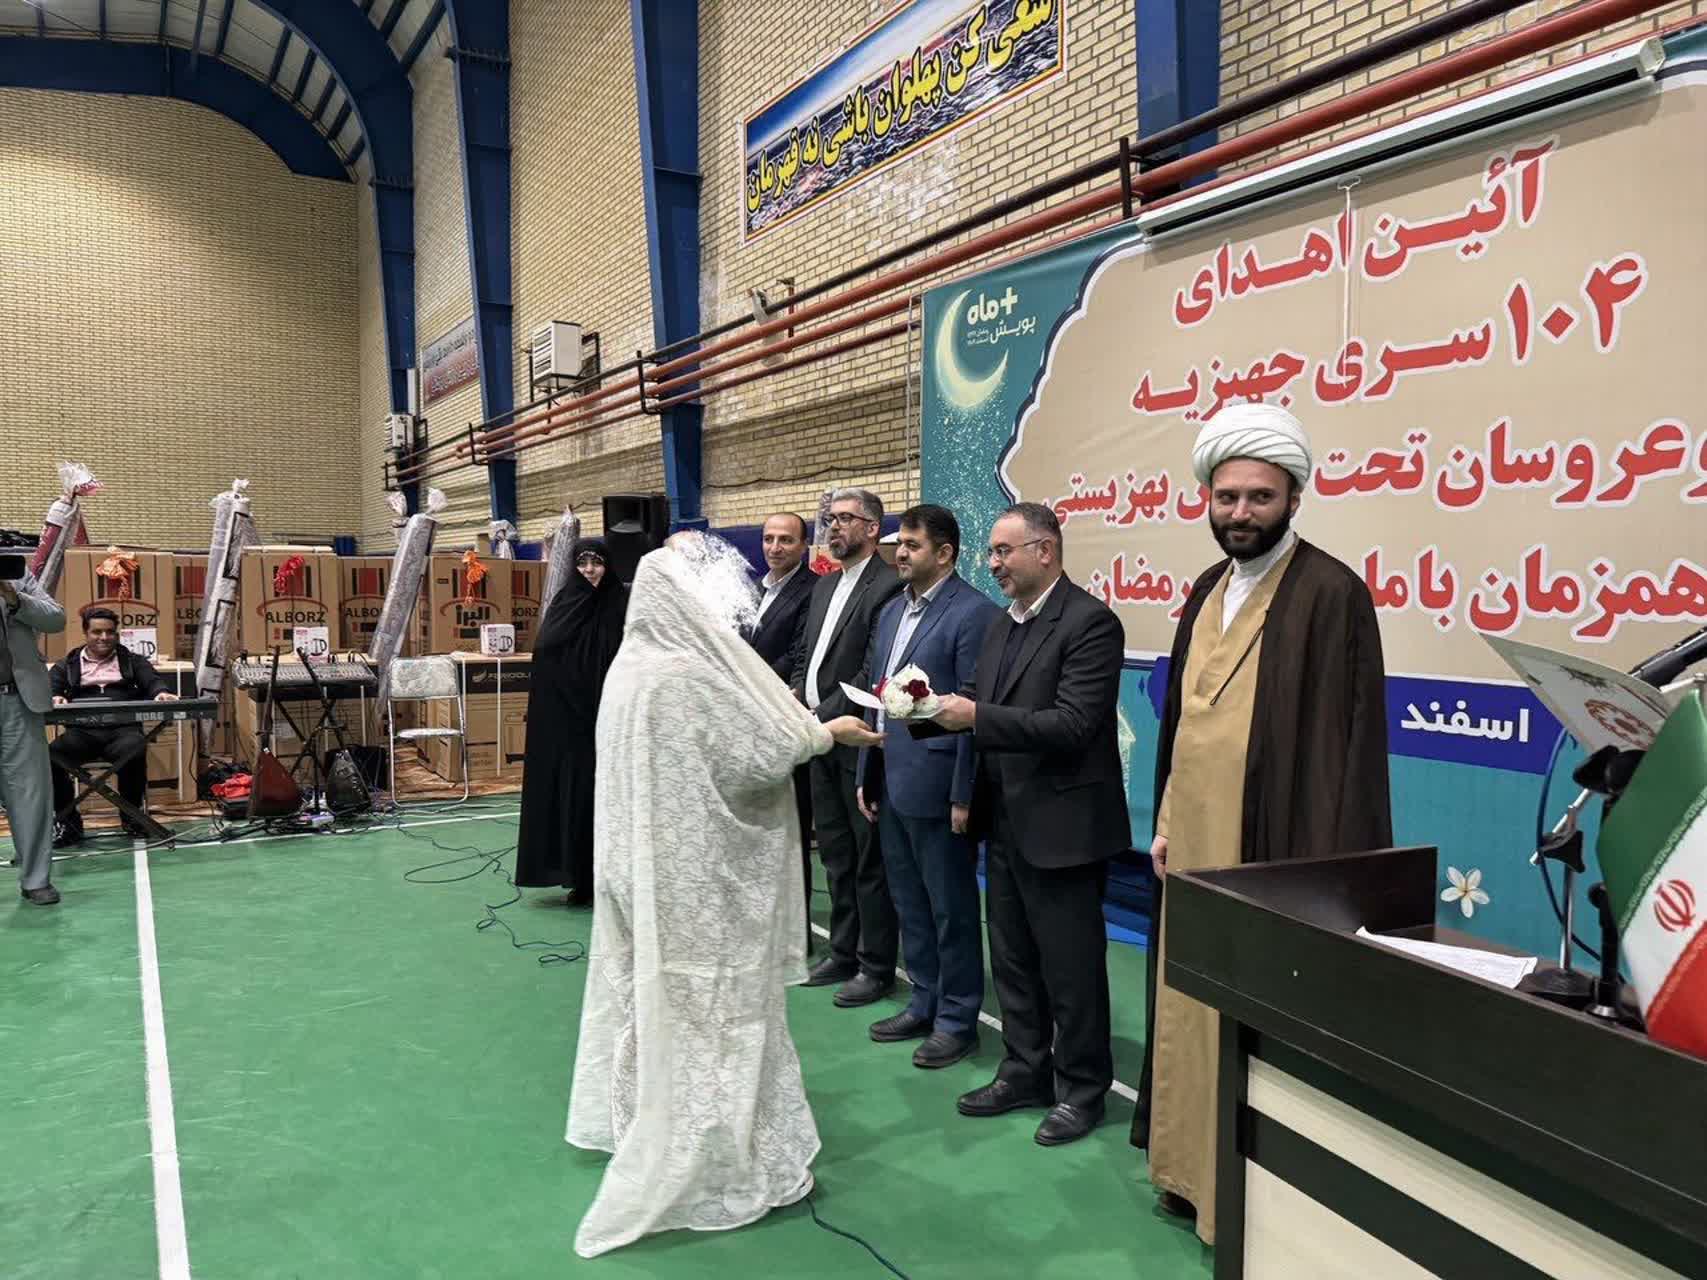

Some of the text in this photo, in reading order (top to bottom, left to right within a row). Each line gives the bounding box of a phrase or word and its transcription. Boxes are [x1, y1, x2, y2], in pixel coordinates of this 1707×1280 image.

[946, 4, 986, 95] کن
[822, 86, 871, 168] باشی
[873, 46, 942, 136] پهلوان
[747, 127, 800, 212] قهرمان
[1175, 140, 1555, 324] آئین اهدای
[990, 316, 1036, 344] پویش
[1506, 256, 1644, 360] ۱۰۴
[1315, 322, 1492, 403] سری
[1043, 473, 1169, 525] بهزیستی
[1313, 431, 1427, 497] تحت
[1436, 422, 1707, 507] عروسان
[265, 611, 326, 623] ALBORZ
[345, 607, 383, 618] ALBO
[1364, 549, 1409, 608] ما
[1418, 549, 1455, 627] با
[1470, 548, 1707, 637] همزمان
[122, 614, 156, 626] ORZ
[1400, 700, 1529, 743] اسفند
